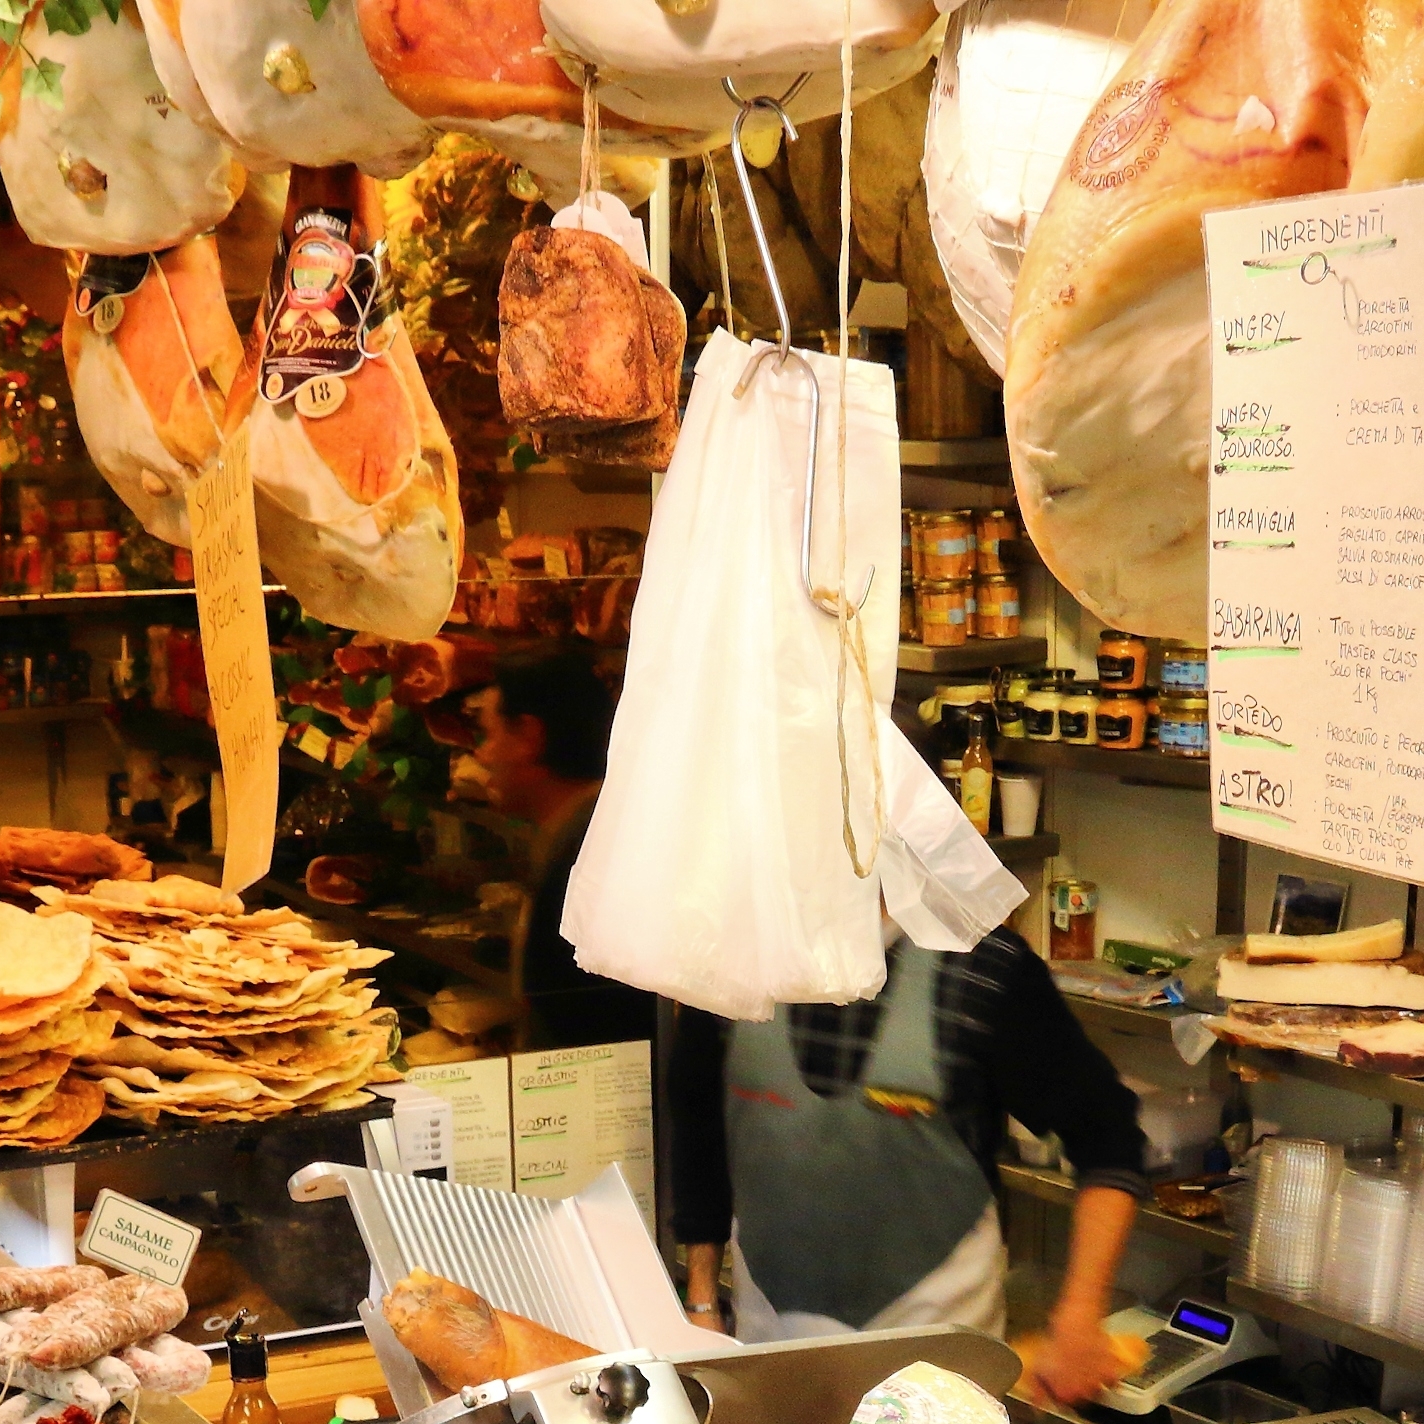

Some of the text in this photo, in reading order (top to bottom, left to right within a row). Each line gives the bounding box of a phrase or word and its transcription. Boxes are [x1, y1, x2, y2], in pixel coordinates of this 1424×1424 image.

[1260, 204, 1385, 254] INGREDIENTI
[100, 302, 115, 320] 18
[1224, 310, 1287, 343] UNGRY
[308, 382, 331, 404] 18
[1221, 402, 1273, 433] UNGRY
[1216, 506, 1296, 534] MARAVIGLIA
[1213, 598, 1302, 645] BABARANGA
[1339, 643, 1418, 668] MASTER CLASS
[1355, 664, 1372, 680] PER
[1213, 690, 1283, 733] TORPEDO
[1218, 769, 1293, 809] ASTRO!
[518, 1159, 570, 1175] SPECIAL
[98, 1227, 180, 1268] CAMPAGNOLO
[114, 1217, 174, 1251] SALAME
